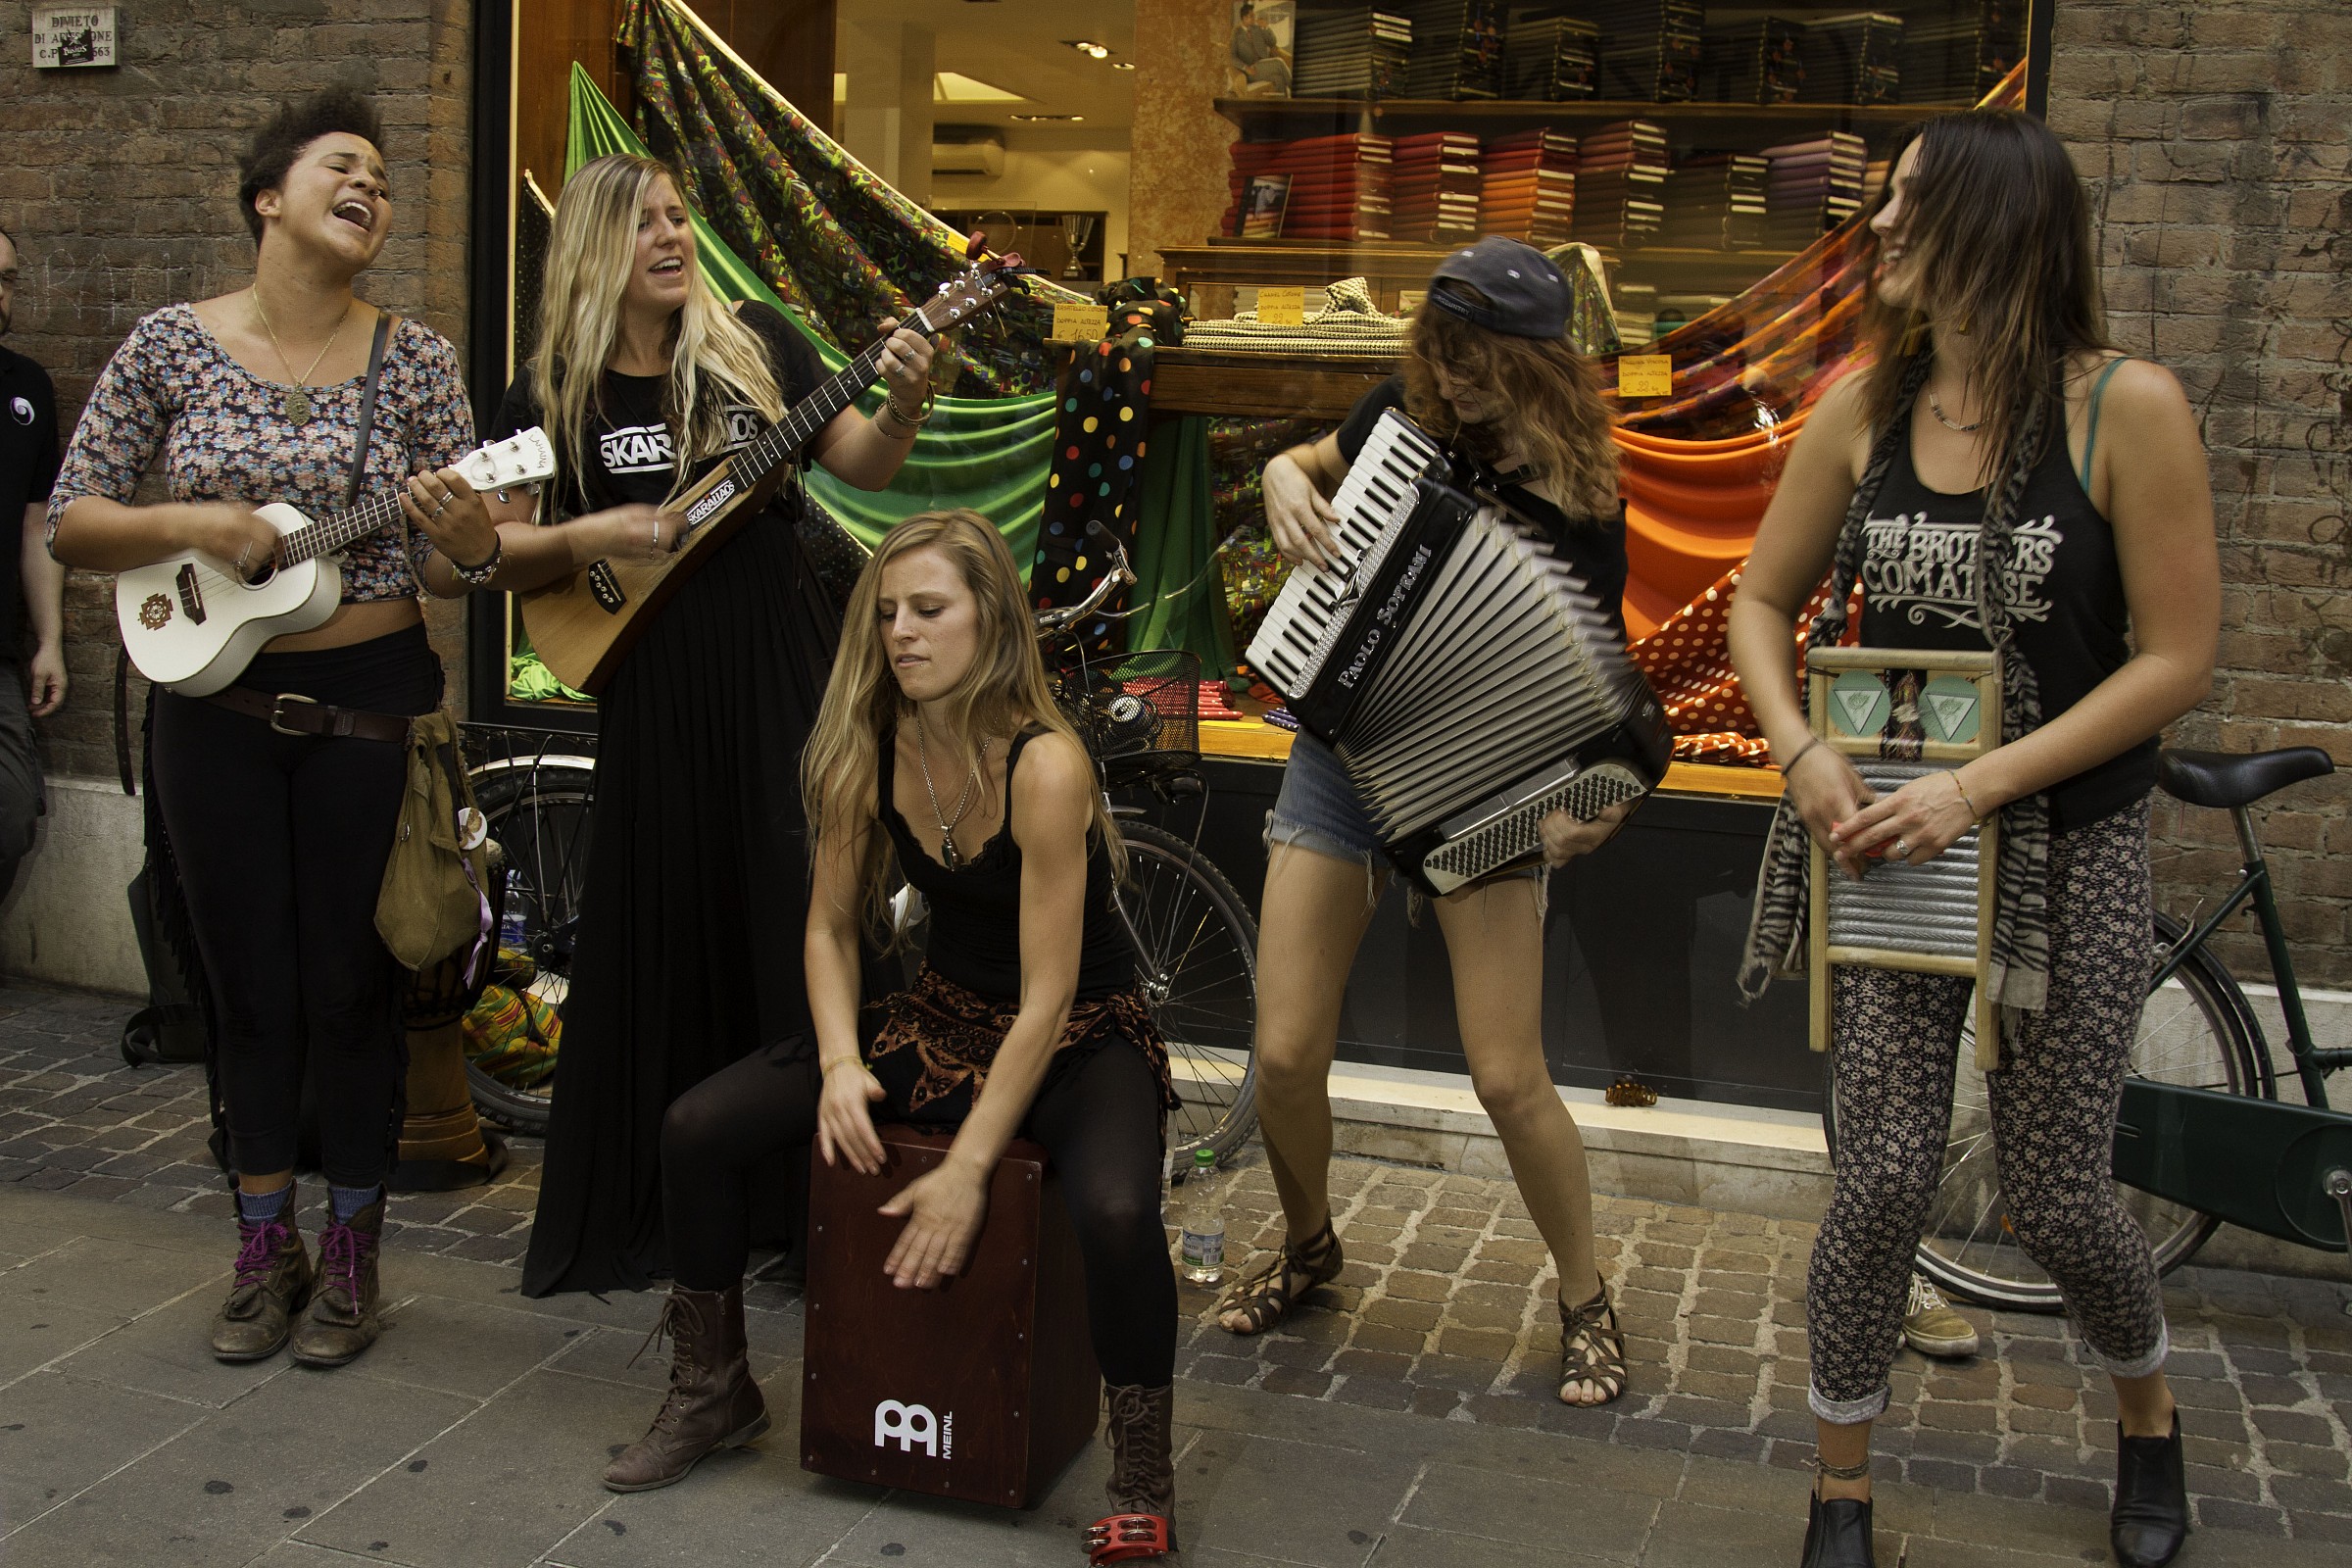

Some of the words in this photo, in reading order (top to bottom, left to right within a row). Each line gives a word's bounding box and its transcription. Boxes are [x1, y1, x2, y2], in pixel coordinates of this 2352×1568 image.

[34, 33, 45, 44] DI
[52, 16, 99, 27] DIVIETO
[1866, 528, 1908, 550] THE
[1906, 529, 2056, 575] BROTRS
[1862, 559, 2044, 608] COMATSE
[1338, 628, 1381, 690] PAOLO
[1377, 544, 1432, 626] SOPRANI
[943, 1411, 953, 1460] MEINL
